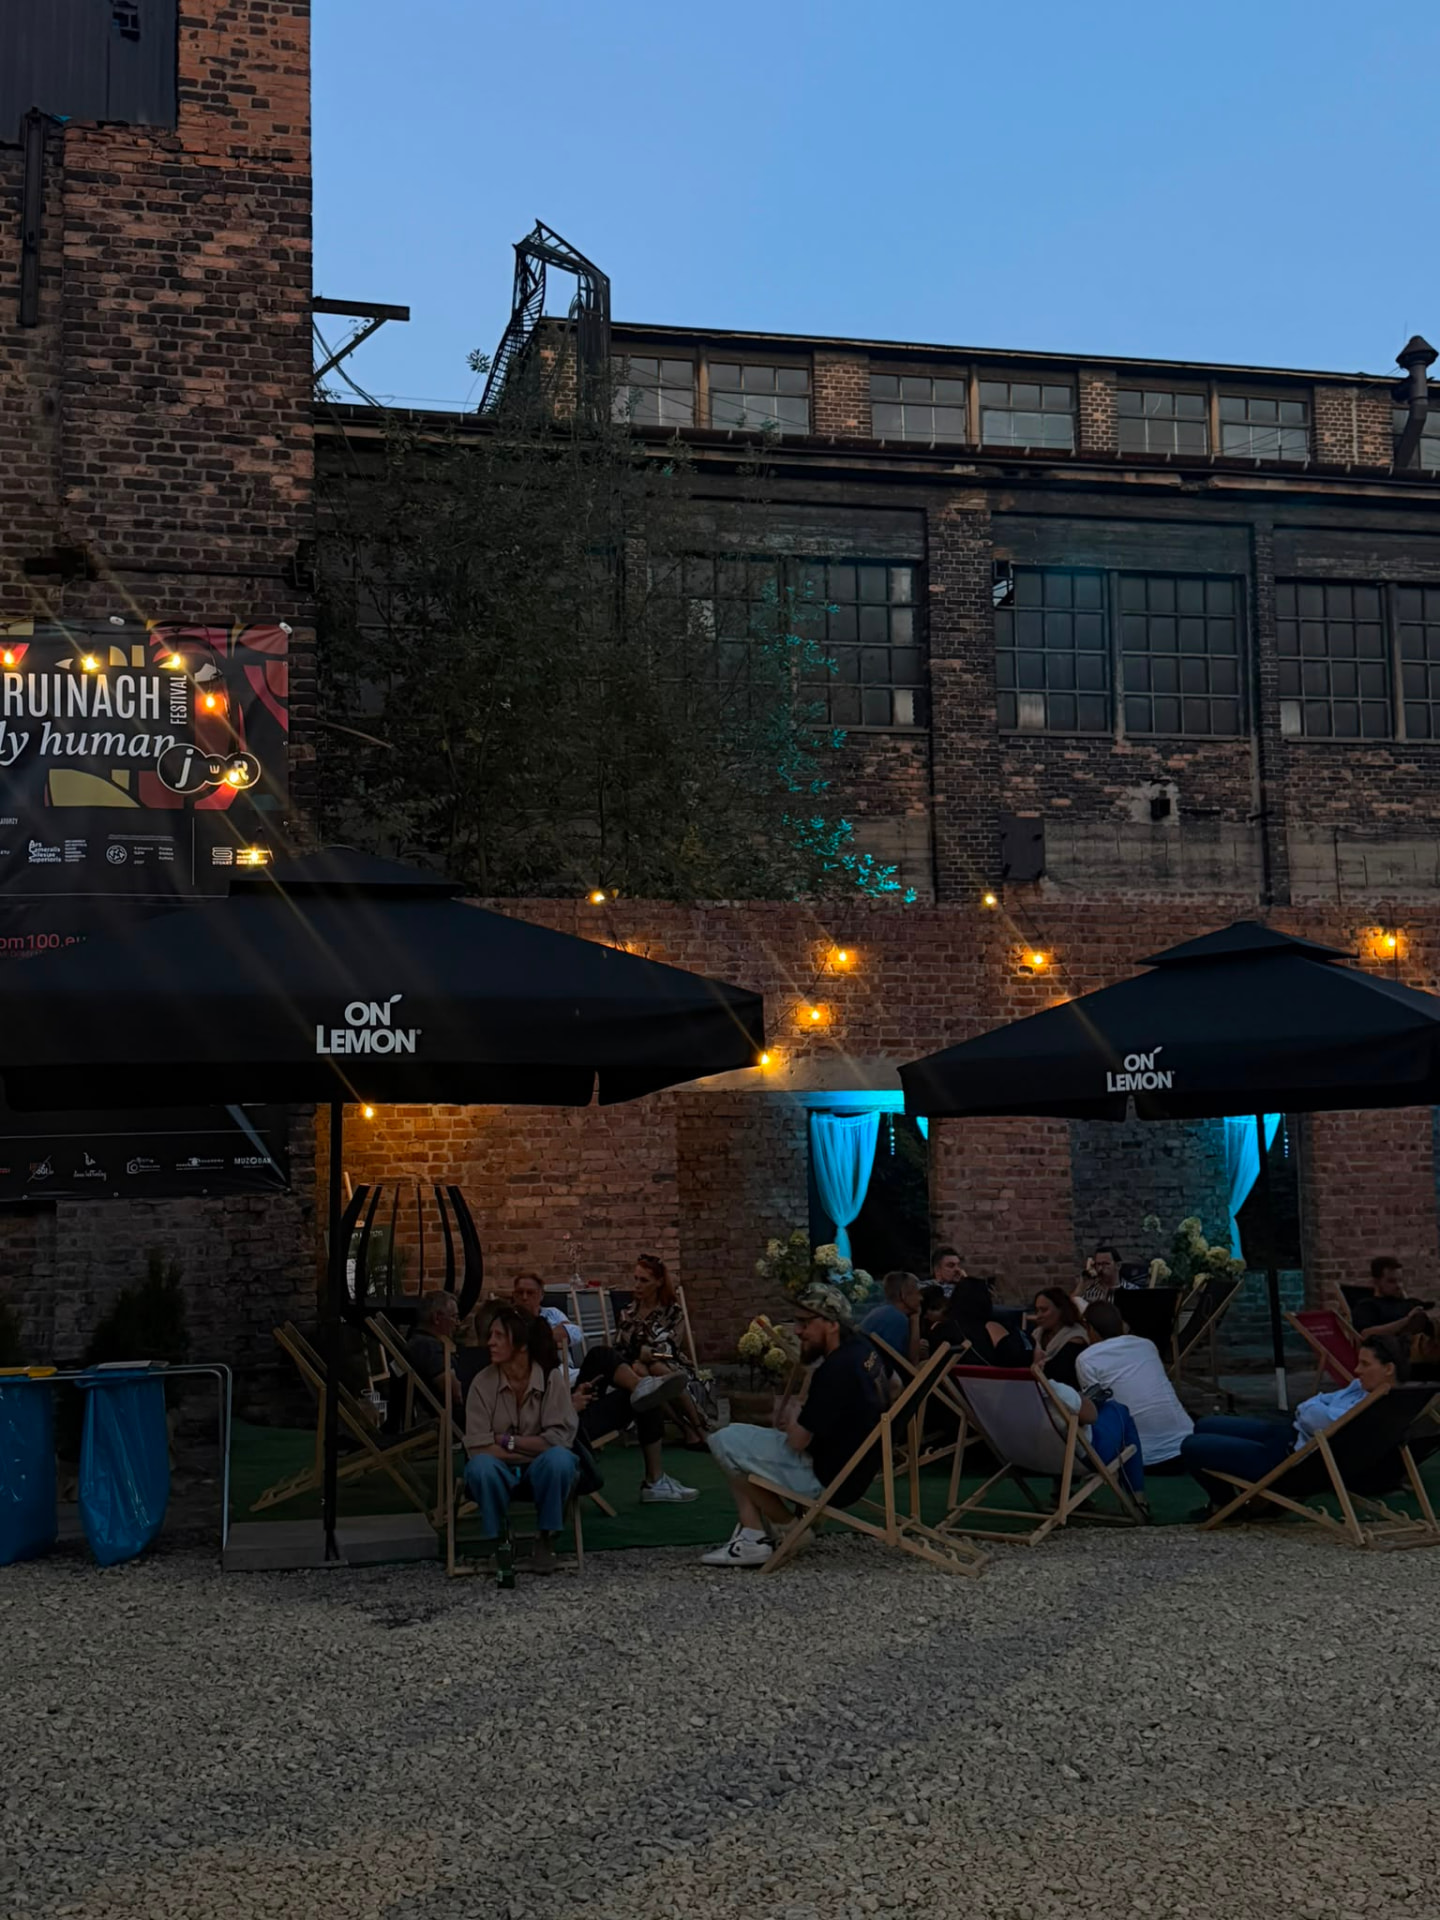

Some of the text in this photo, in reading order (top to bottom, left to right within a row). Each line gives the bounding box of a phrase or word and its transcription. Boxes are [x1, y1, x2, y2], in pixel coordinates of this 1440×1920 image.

[4, 671, 160, 720] RUINACH
[169, 674, 188, 725] FESTIVAL
[39, 719, 175, 759] human
[344, 999, 393, 1027] ON
[315, 1024, 418, 1054] LEMON
[1123, 1051, 1157, 1073] ON
[1106, 1071, 1174, 1093] LEMON
